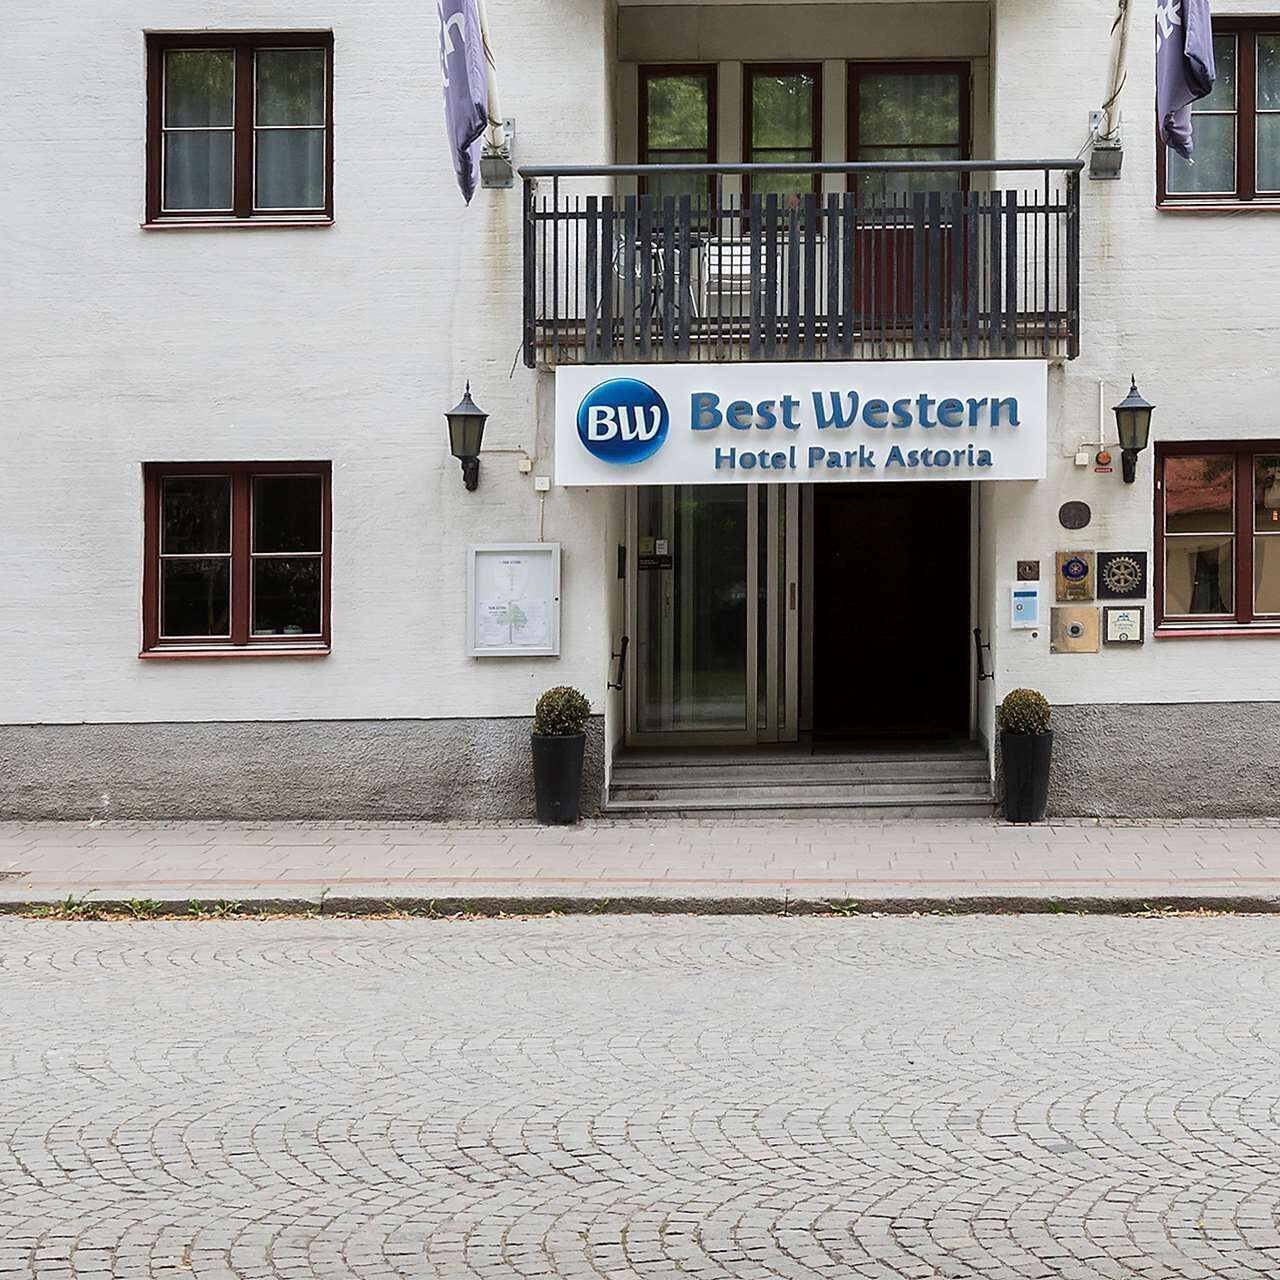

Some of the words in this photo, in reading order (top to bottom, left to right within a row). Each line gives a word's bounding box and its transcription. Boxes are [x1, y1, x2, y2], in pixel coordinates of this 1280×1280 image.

[587, 404, 662, 442] BW
[689, 391, 801, 432] Best
[811, 390, 1020, 430] Western
[714, 446, 796, 470] Hotel
[807, 445, 876, 469] Park
[884, 444, 993, 468] Astoria
